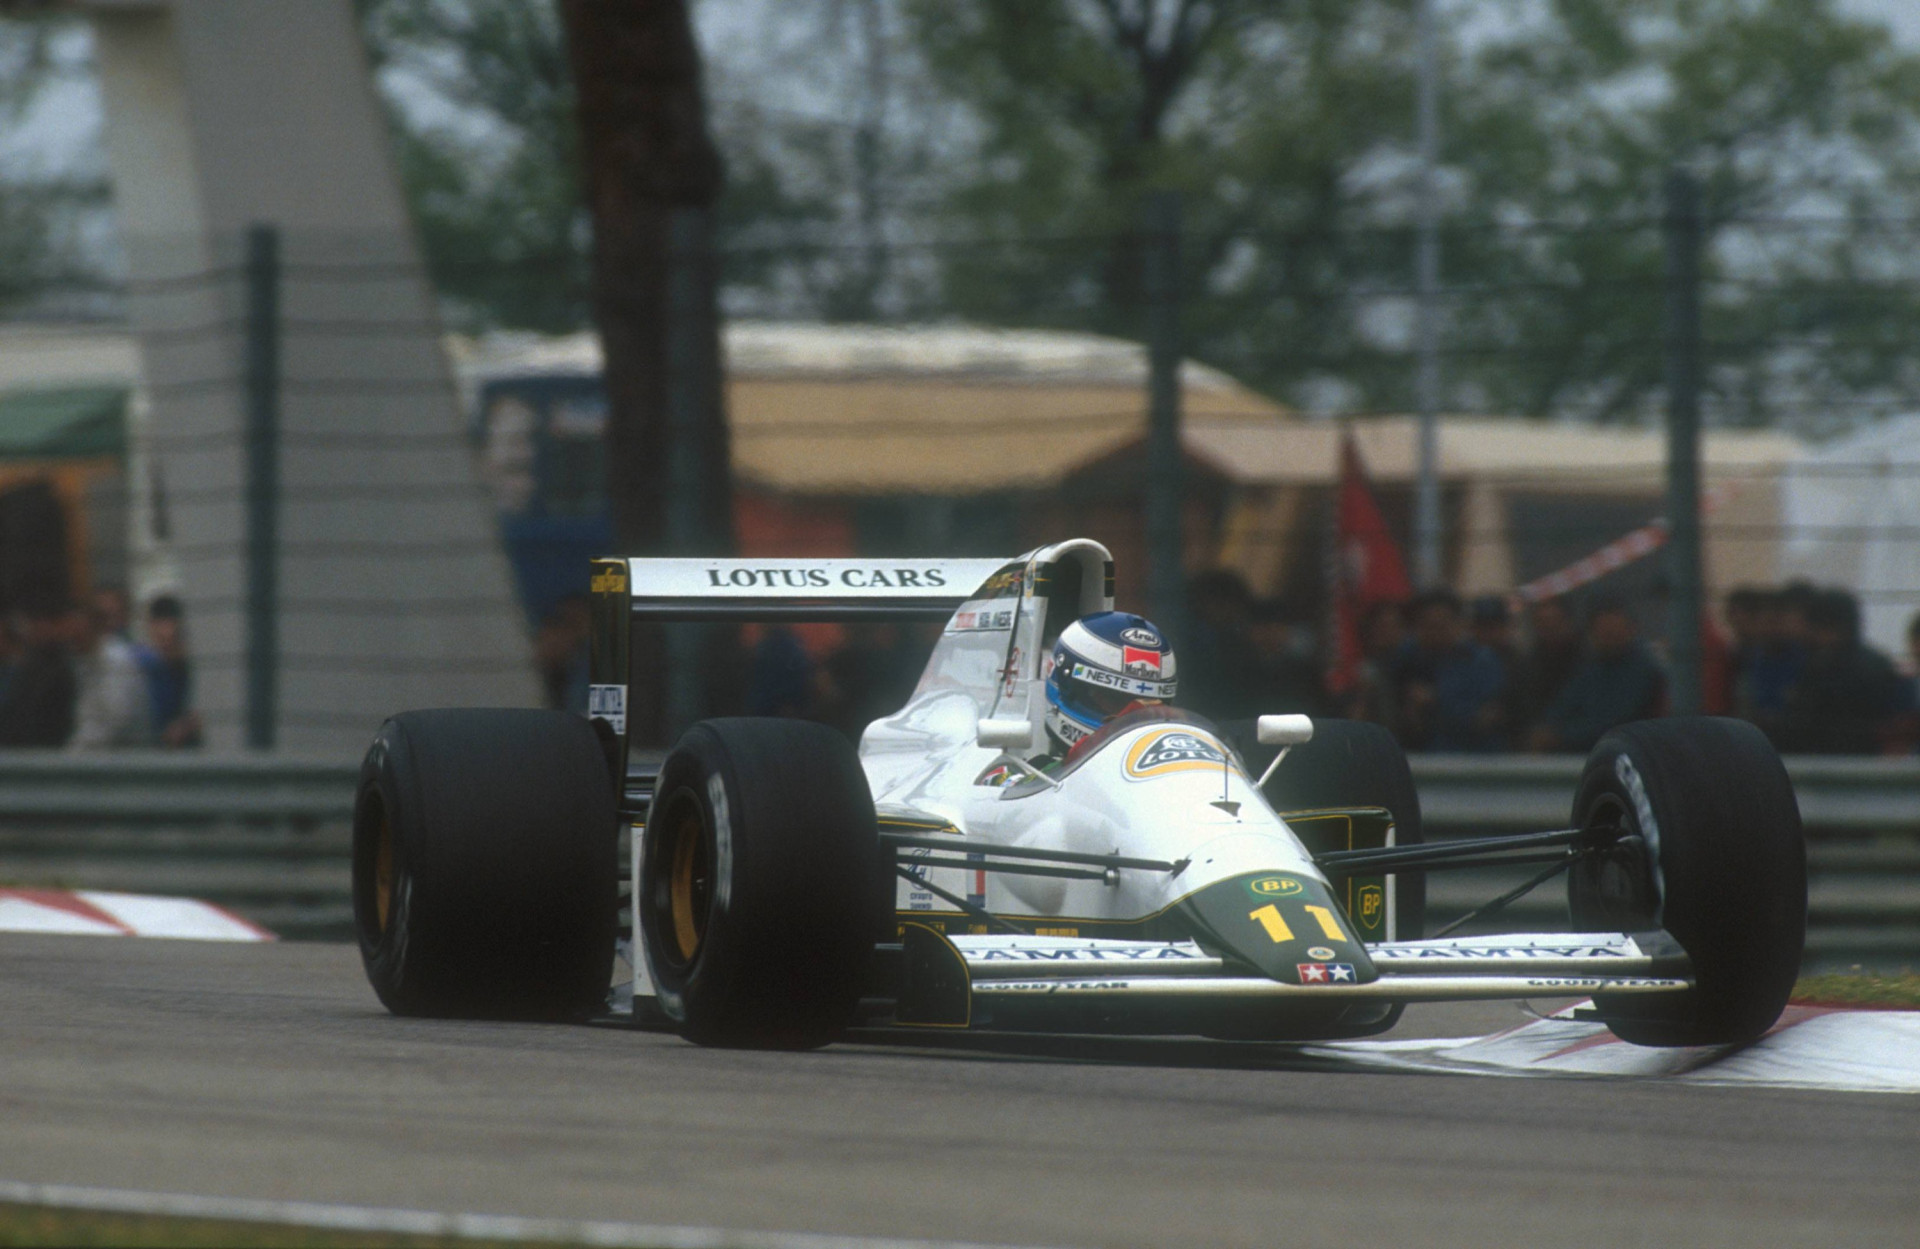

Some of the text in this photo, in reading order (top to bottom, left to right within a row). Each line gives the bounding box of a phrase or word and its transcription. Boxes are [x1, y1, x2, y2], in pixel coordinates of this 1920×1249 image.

[707, 568, 947, 588] LOTUS CARS
[1129, 630, 1157, 643] Arai
[1086, 669, 1131, 689] NESTE
[1125, 663, 1161, 680] Marlboro
[1261, 880, 1297, 892] BP
[1363, 893, 1381, 915] BP
[1249, 903, 1348, 943] 11
[1369, 947, 1629, 959] TAMIYA
[1528, 978, 1676, 990] GOODYEAR
